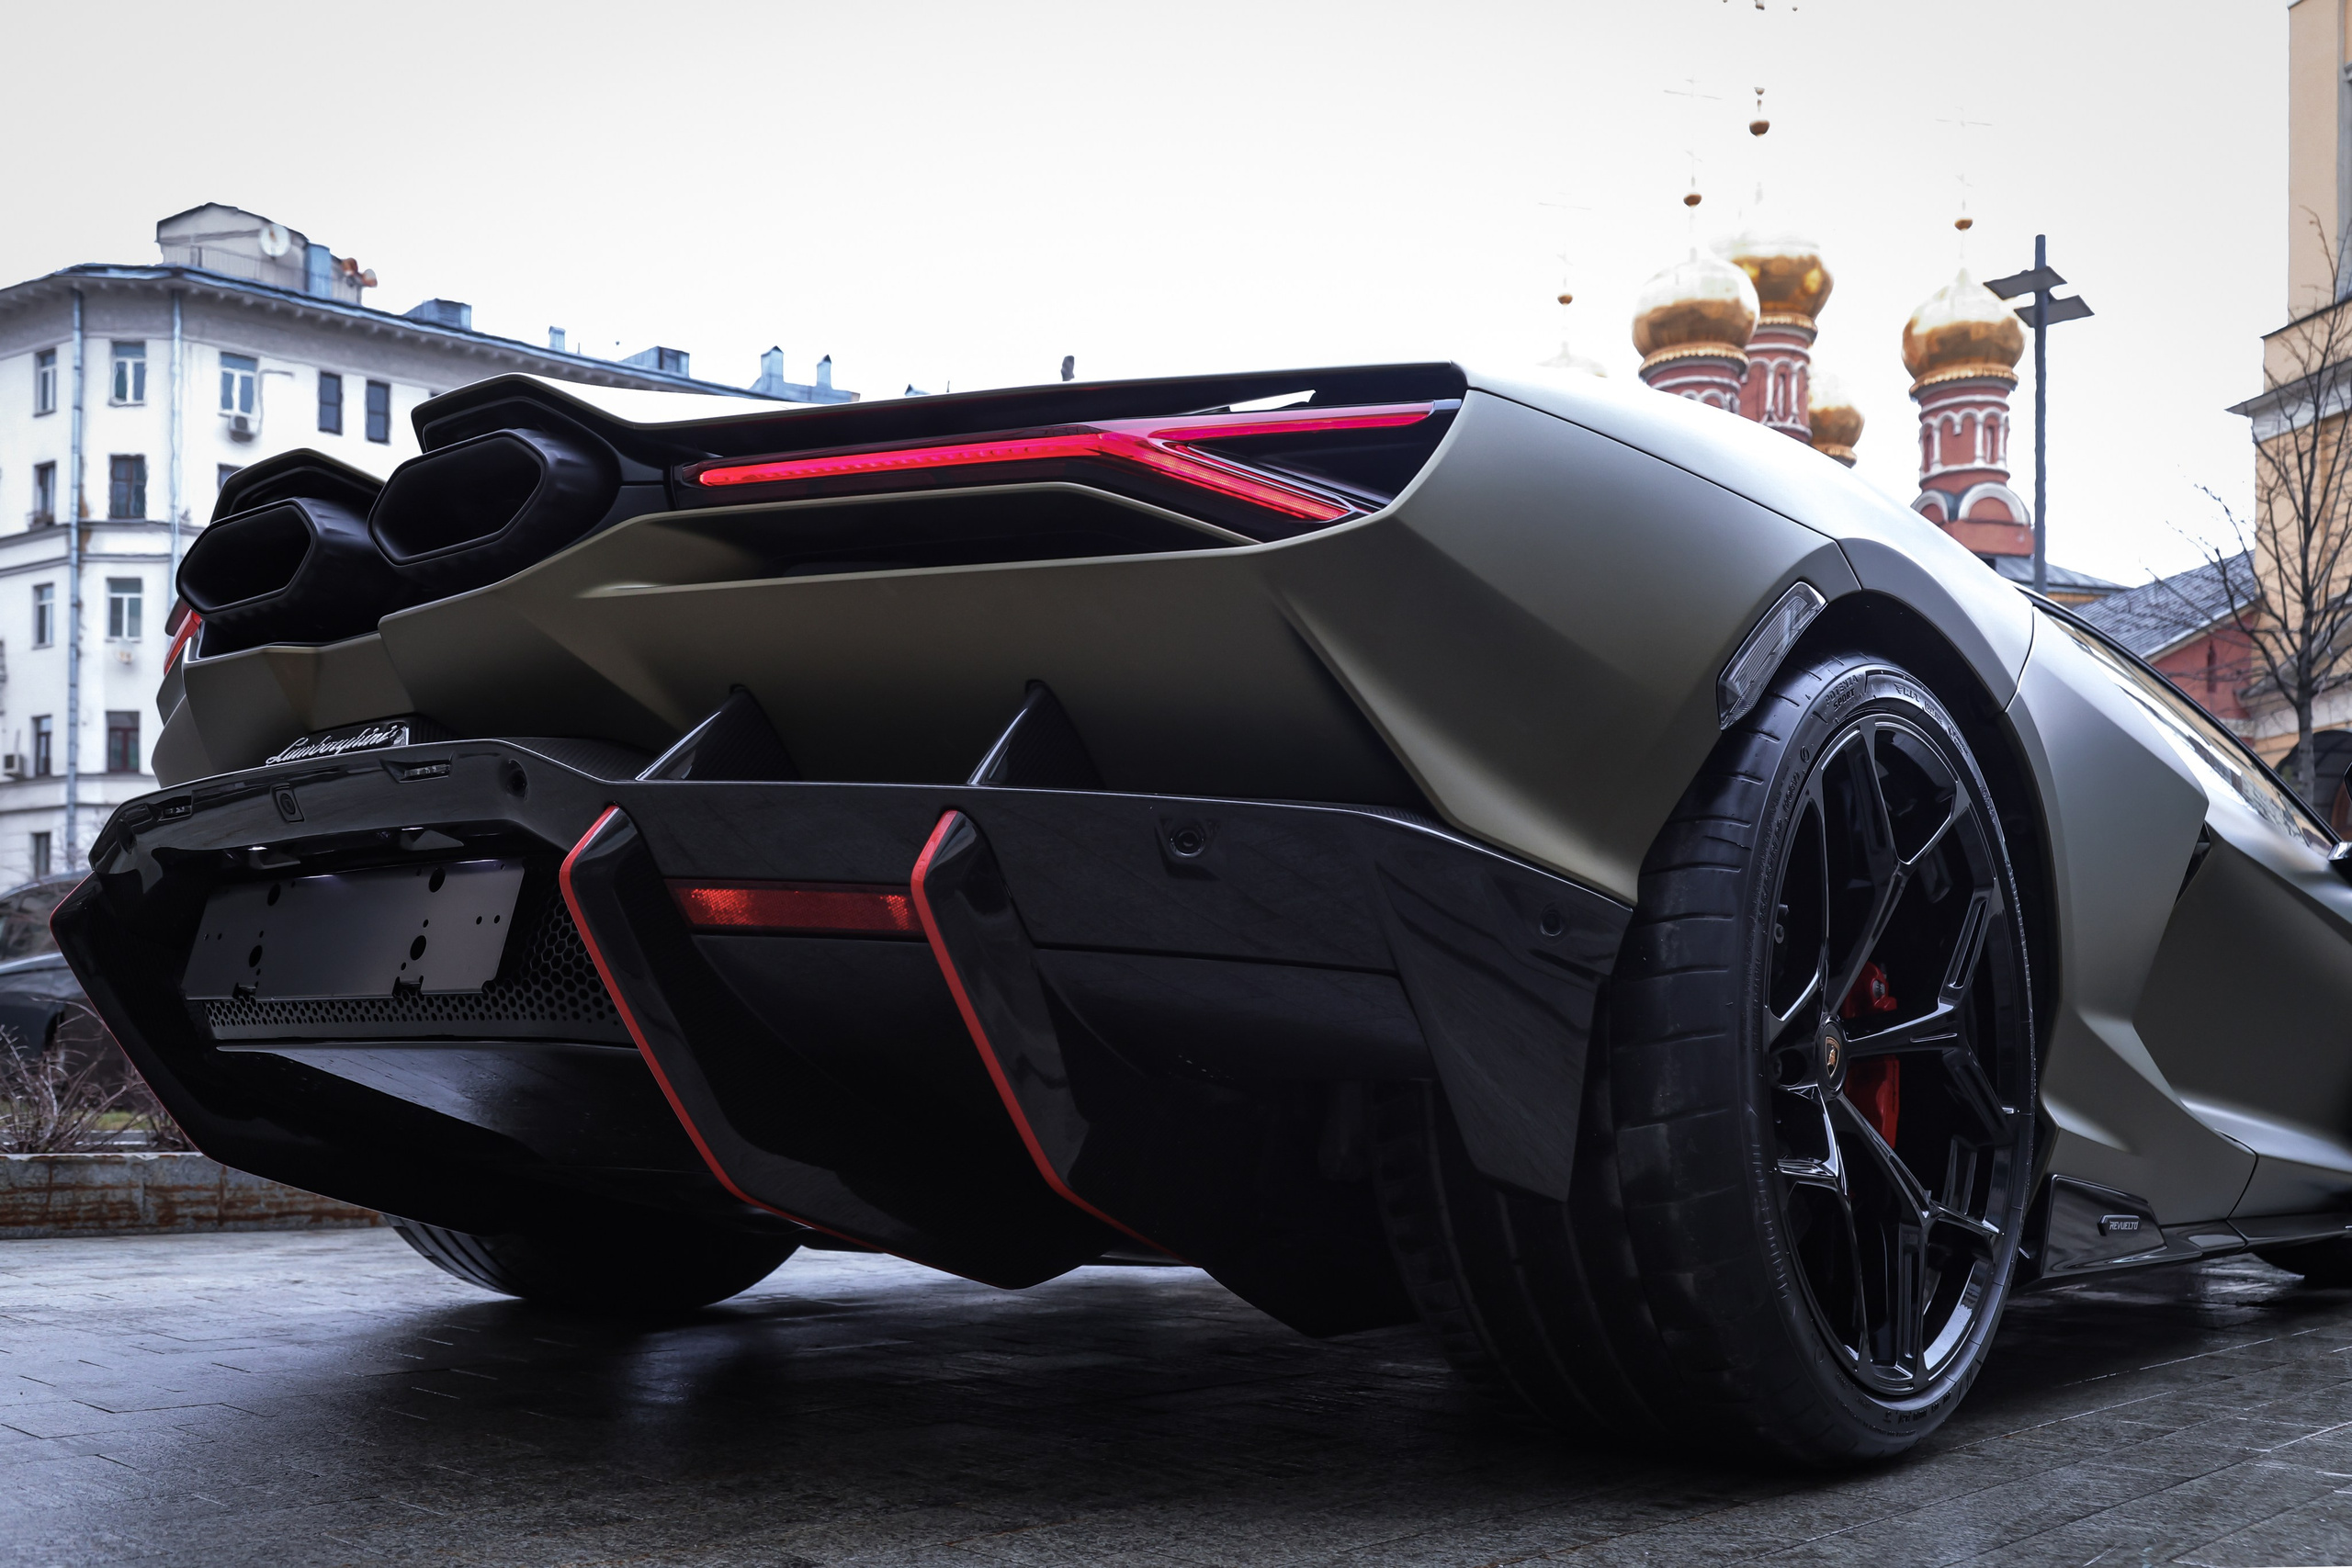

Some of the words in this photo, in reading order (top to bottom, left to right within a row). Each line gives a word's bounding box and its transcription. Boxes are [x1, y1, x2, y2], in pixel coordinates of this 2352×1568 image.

[1825, 674, 1859, 706] POTENZA
[1833, 688, 1855, 712] SPORT
[266, 725, 398, 766] Lamborghini
[2109, 1221, 2139, 1231] REVUELTO
